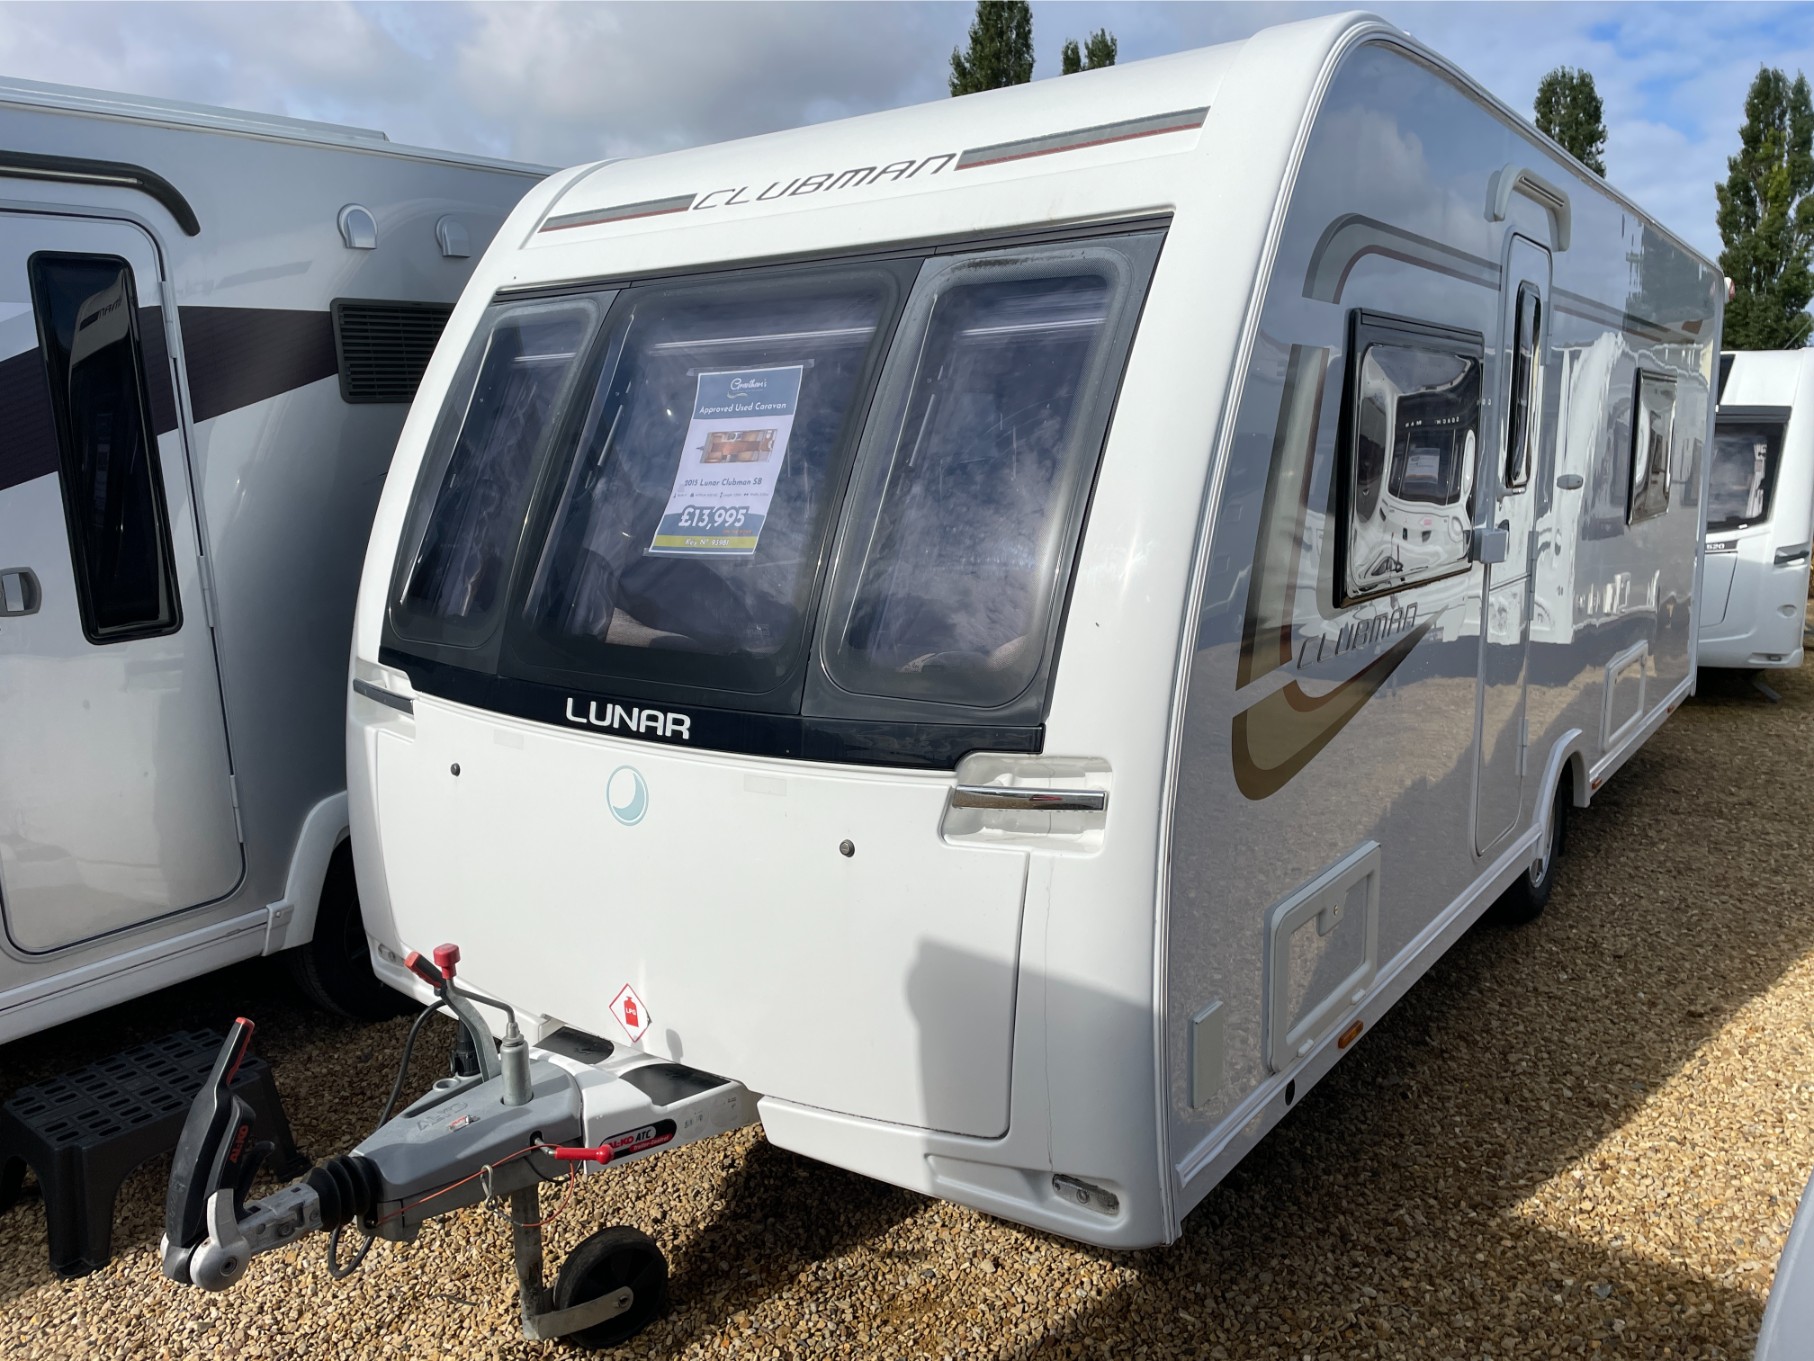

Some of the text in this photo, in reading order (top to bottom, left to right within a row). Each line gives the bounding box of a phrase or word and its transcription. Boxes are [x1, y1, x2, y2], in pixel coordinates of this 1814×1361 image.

[692, 153, 957, 211] CLUBMAN
[699, 401, 787, 415] Approved Used Caravan
[699, 478, 720, 487] Lunar
[721, 478, 751, 486] Clubman
[678, 506, 747, 530] £13,995
[1297, 602, 1418, 670] CLUBMAN
[565, 697, 691, 740] LUNAR
[635, 1129, 653, 1142] ATC
